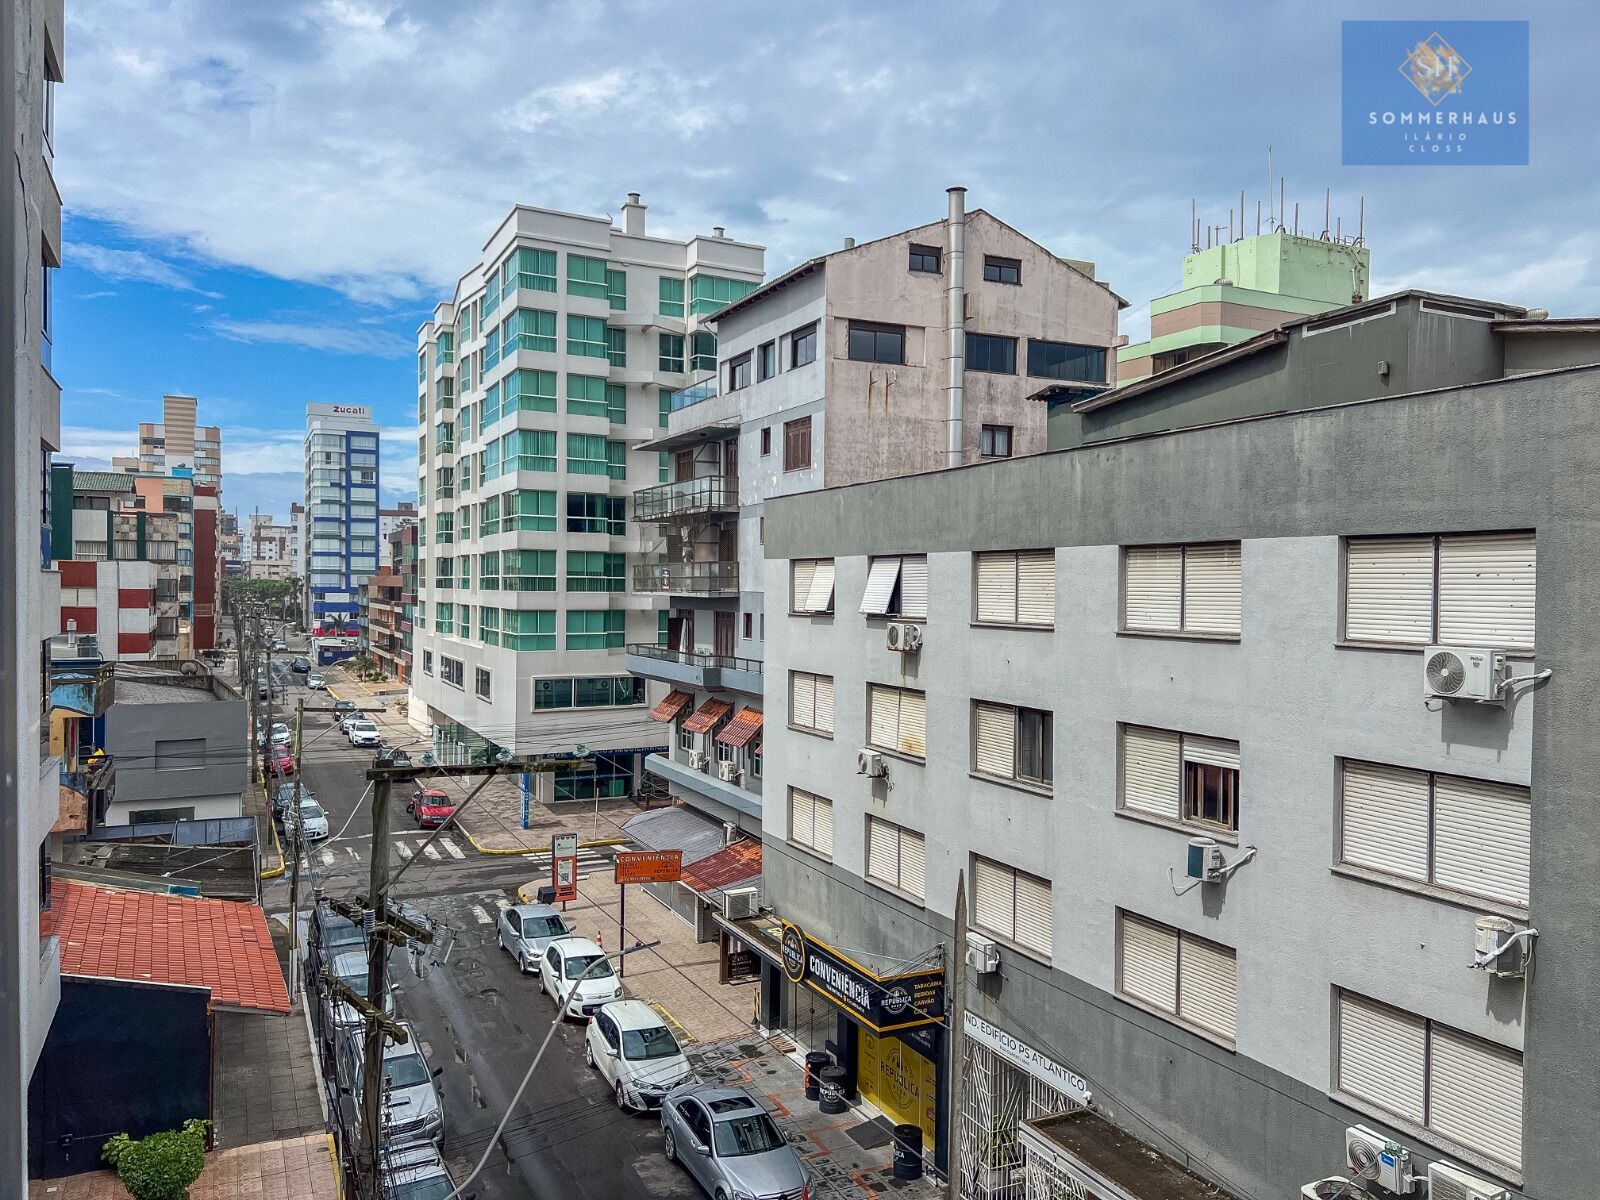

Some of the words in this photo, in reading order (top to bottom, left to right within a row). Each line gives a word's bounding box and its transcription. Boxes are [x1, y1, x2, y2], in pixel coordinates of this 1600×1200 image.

[333, 405, 365, 415] Zucati
[809, 955, 870, 1010] CONVENIÊNCIA
[1018, 1045, 1030, 1059] PS
